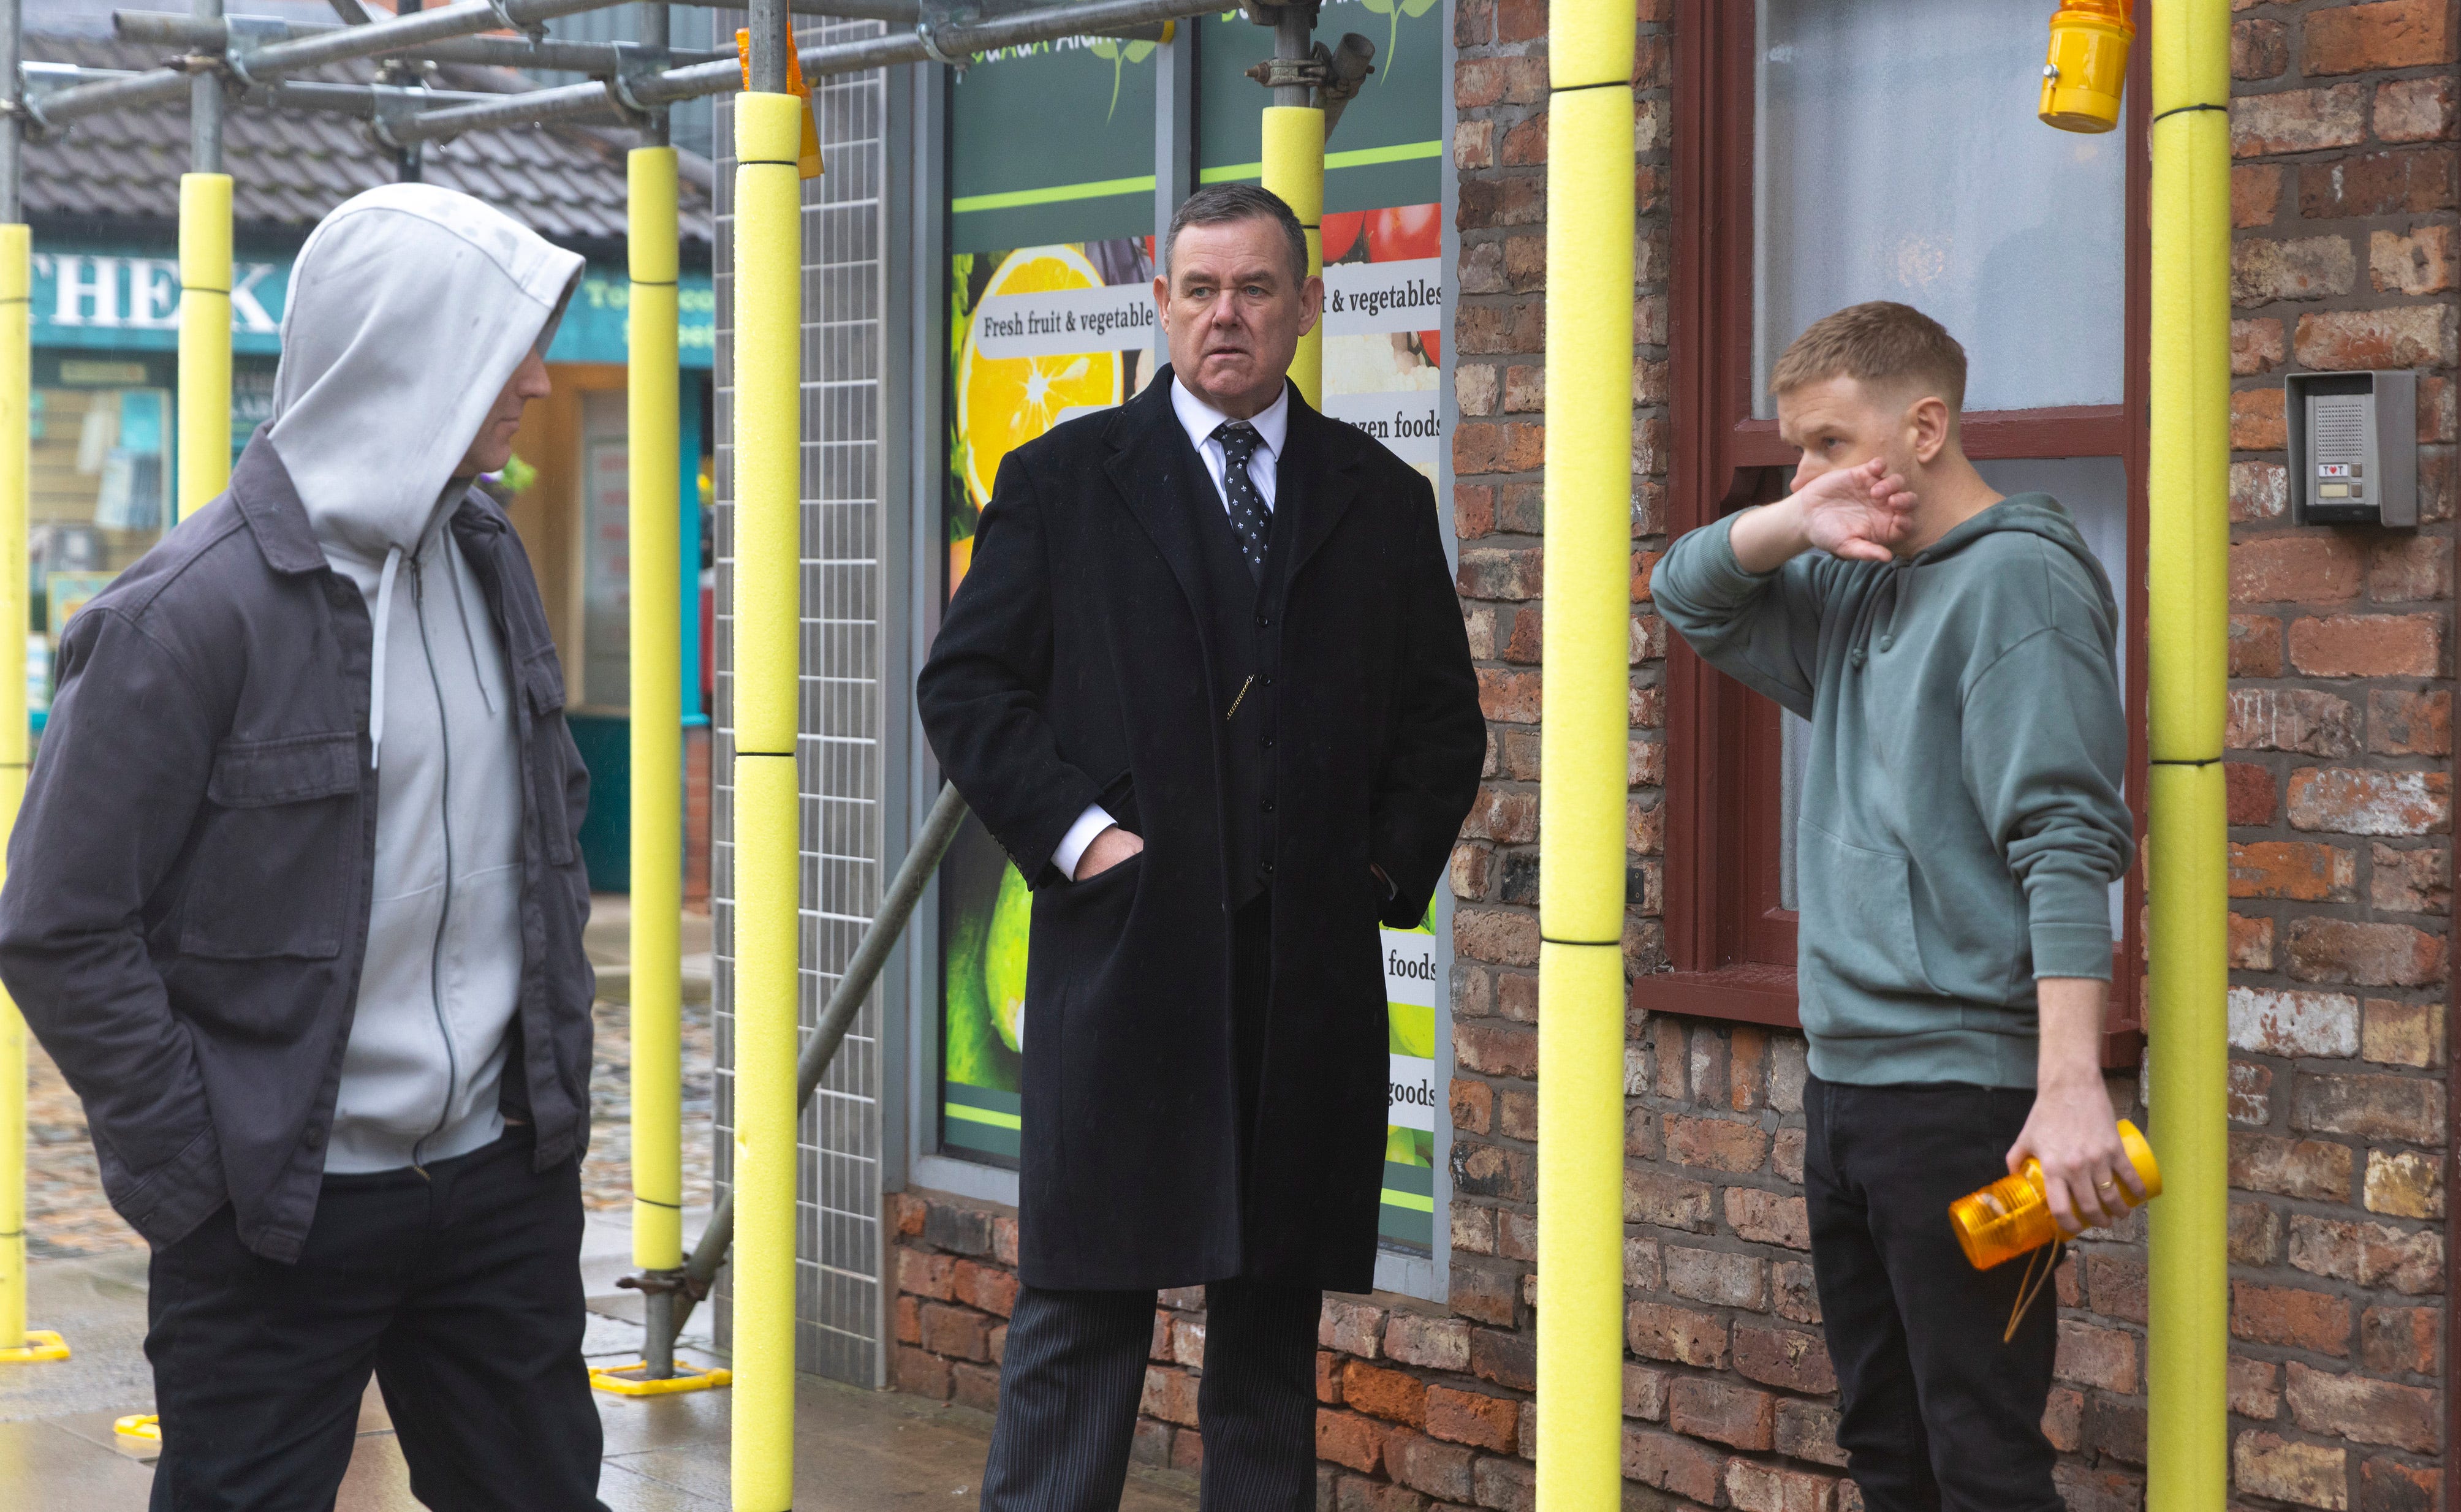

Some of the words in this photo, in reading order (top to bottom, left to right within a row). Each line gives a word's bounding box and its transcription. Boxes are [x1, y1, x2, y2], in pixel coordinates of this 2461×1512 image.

[1332, 289, 1344, 312] &
[984, 312, 1023, 338] Fresh
[1028, 310, 1061, 335] fruit
[1066, 311, 1076, 331] &
[1081, 301, 1154, 335] vegetable
